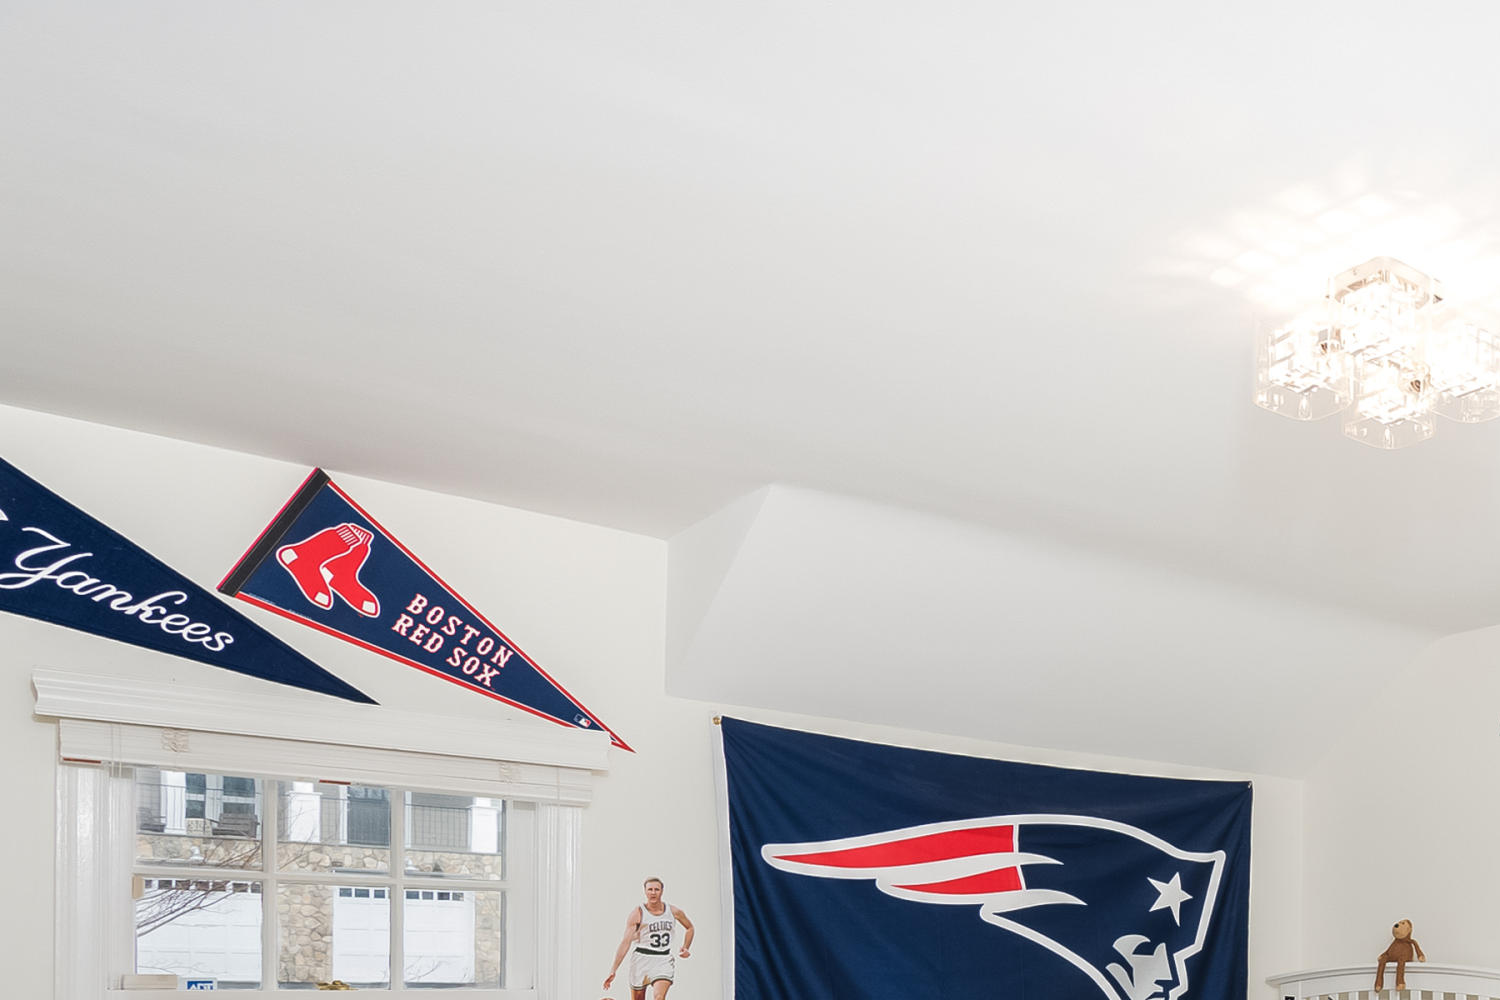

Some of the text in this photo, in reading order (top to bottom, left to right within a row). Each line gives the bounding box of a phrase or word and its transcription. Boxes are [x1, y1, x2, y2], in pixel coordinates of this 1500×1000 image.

[0, 526, 235, 652] Yankees
[391, 613, 501, 687] RED SOX
[405, 593, 514, 668] BOSTON
[650, 933, 670, 948] 33
